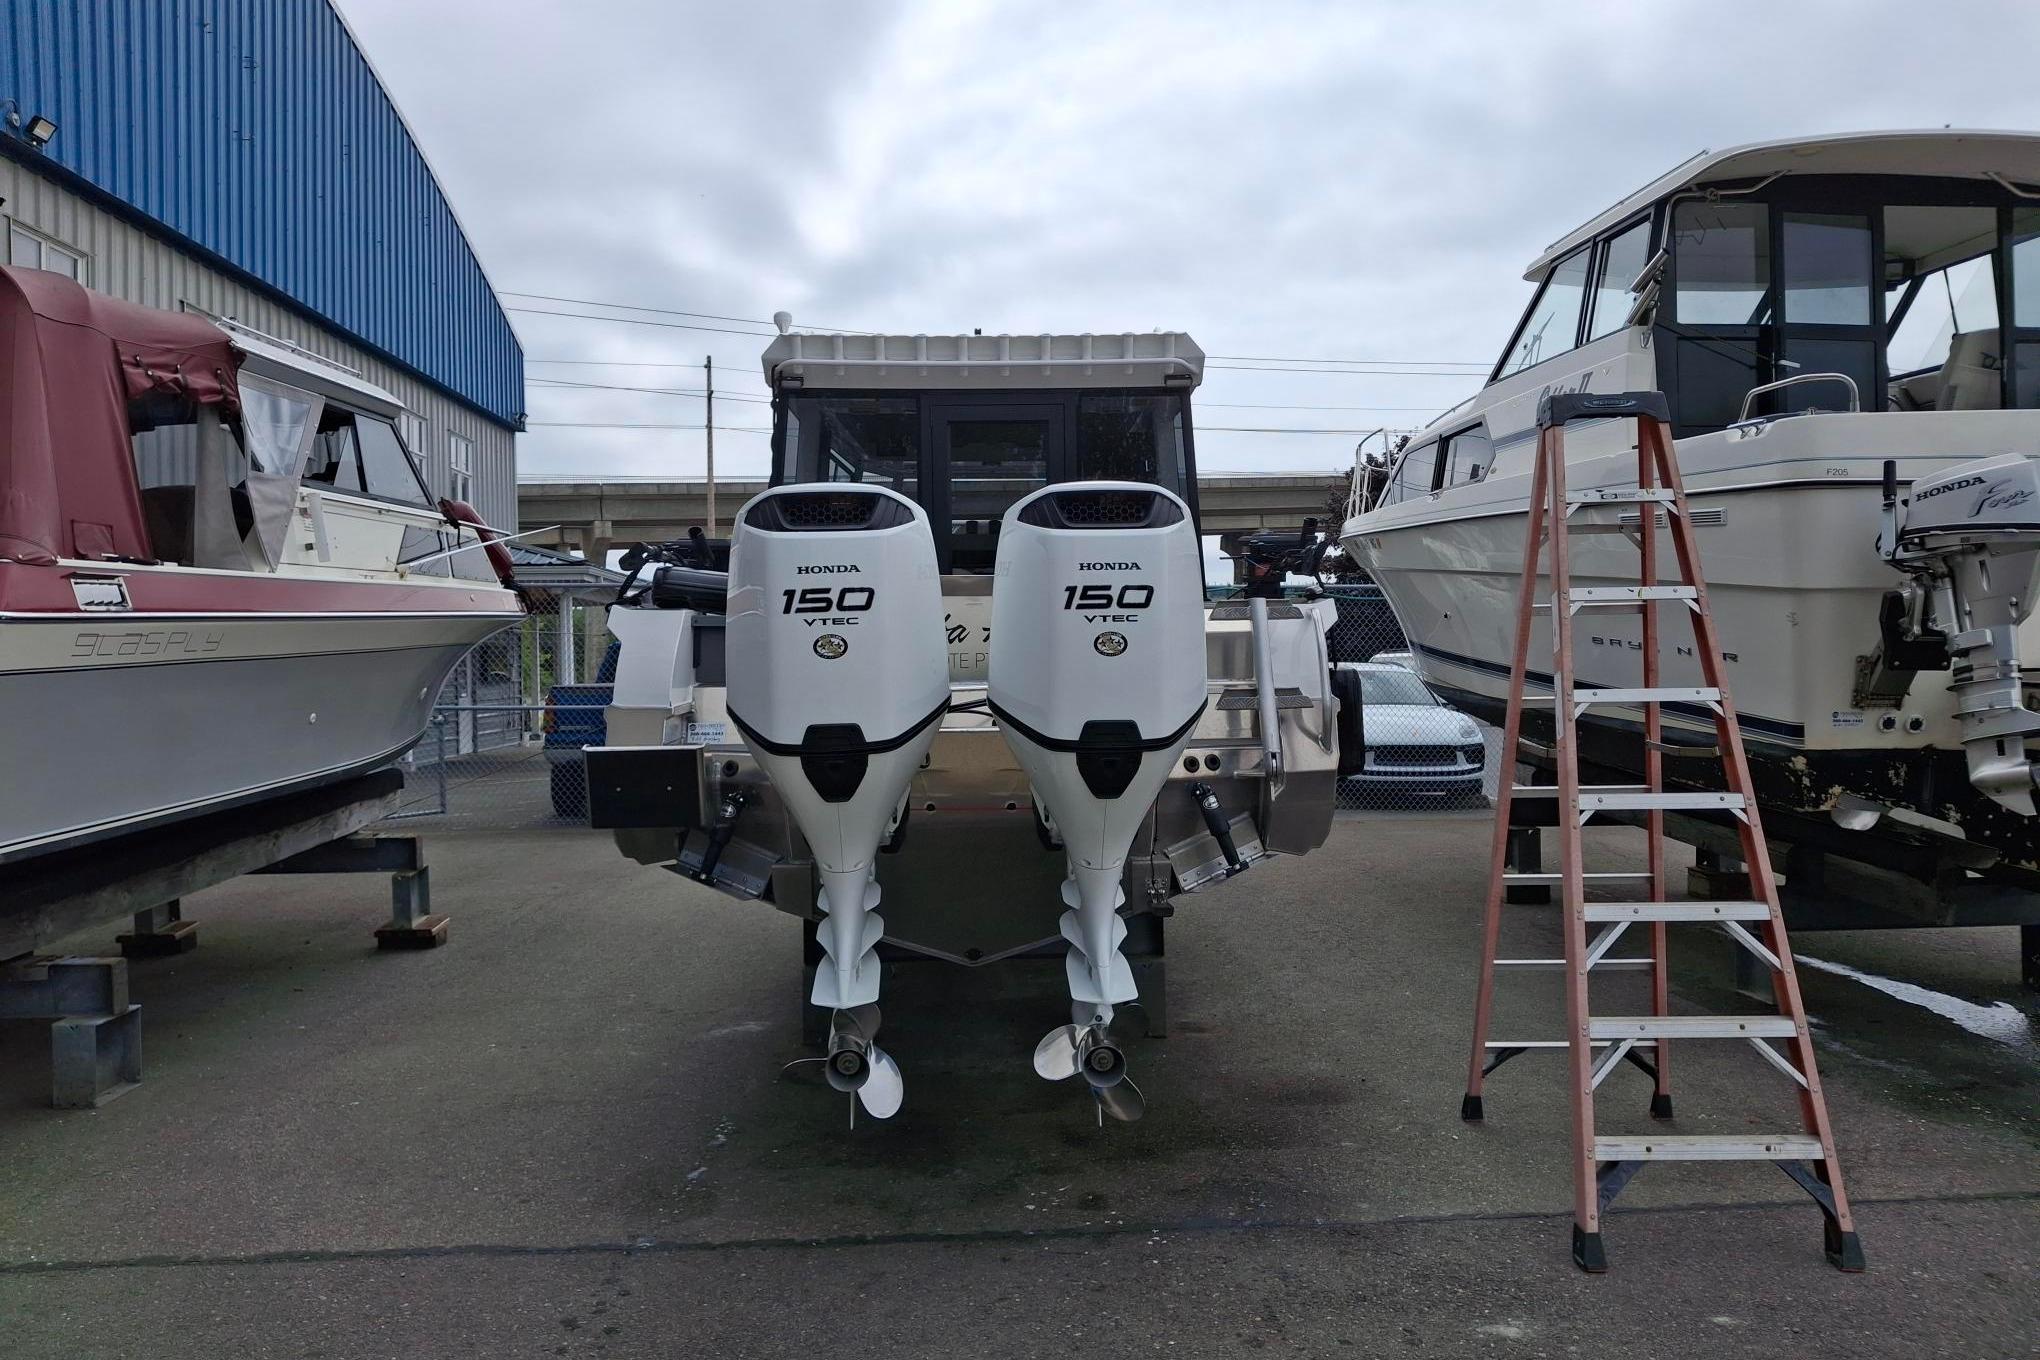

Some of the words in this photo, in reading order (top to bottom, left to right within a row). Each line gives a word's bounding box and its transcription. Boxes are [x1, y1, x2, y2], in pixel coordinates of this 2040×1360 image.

[1826, 468, 1848, 476] F205
[1915, 476, 1986, 502] HONDA
[796, 564, 862, 575] HONDA
[1078, 562, 1142, 571] HONDA
[782, 587, 875, 615] 150
[1063, 584, 1155, 610] 150
[803, 617, 860, 627] VTEC
[1083, 614, 1139, 624] VTEC
